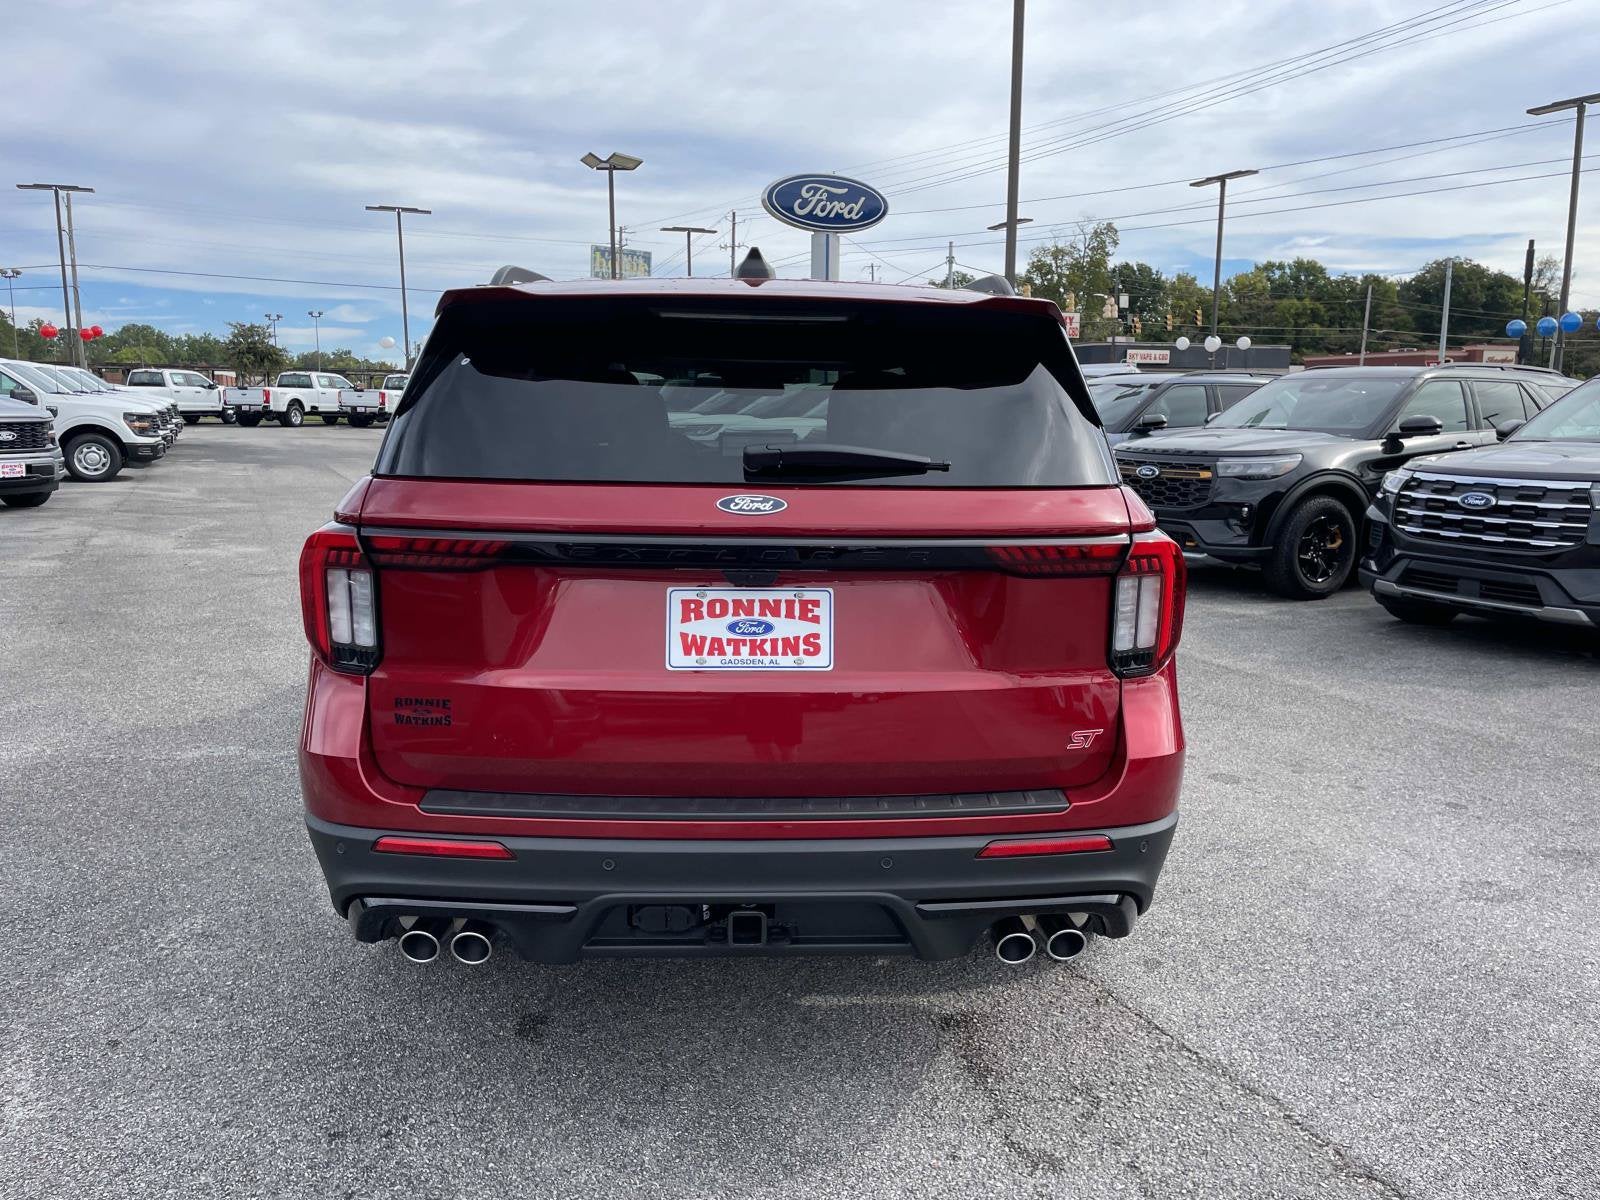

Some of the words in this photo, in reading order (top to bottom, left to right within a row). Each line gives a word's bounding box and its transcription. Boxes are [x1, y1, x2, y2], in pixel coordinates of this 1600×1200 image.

[794, 183, 866, 220] Ford
[729, 495, 773, 512] Ford
[1464, 495, 1486, 506] Ford
[680, 599, 821, 625] RONNIE
[735, 621, 765, 634] Ford
[679, 632, 822, 657] WATKINS
[720, 658, 767, 666] GADSDEN,
[394, 697, 452, 710] RONNIE
[394, 713, 452, 726] WATKINS
[1067, 728, 1104, 749] ST
